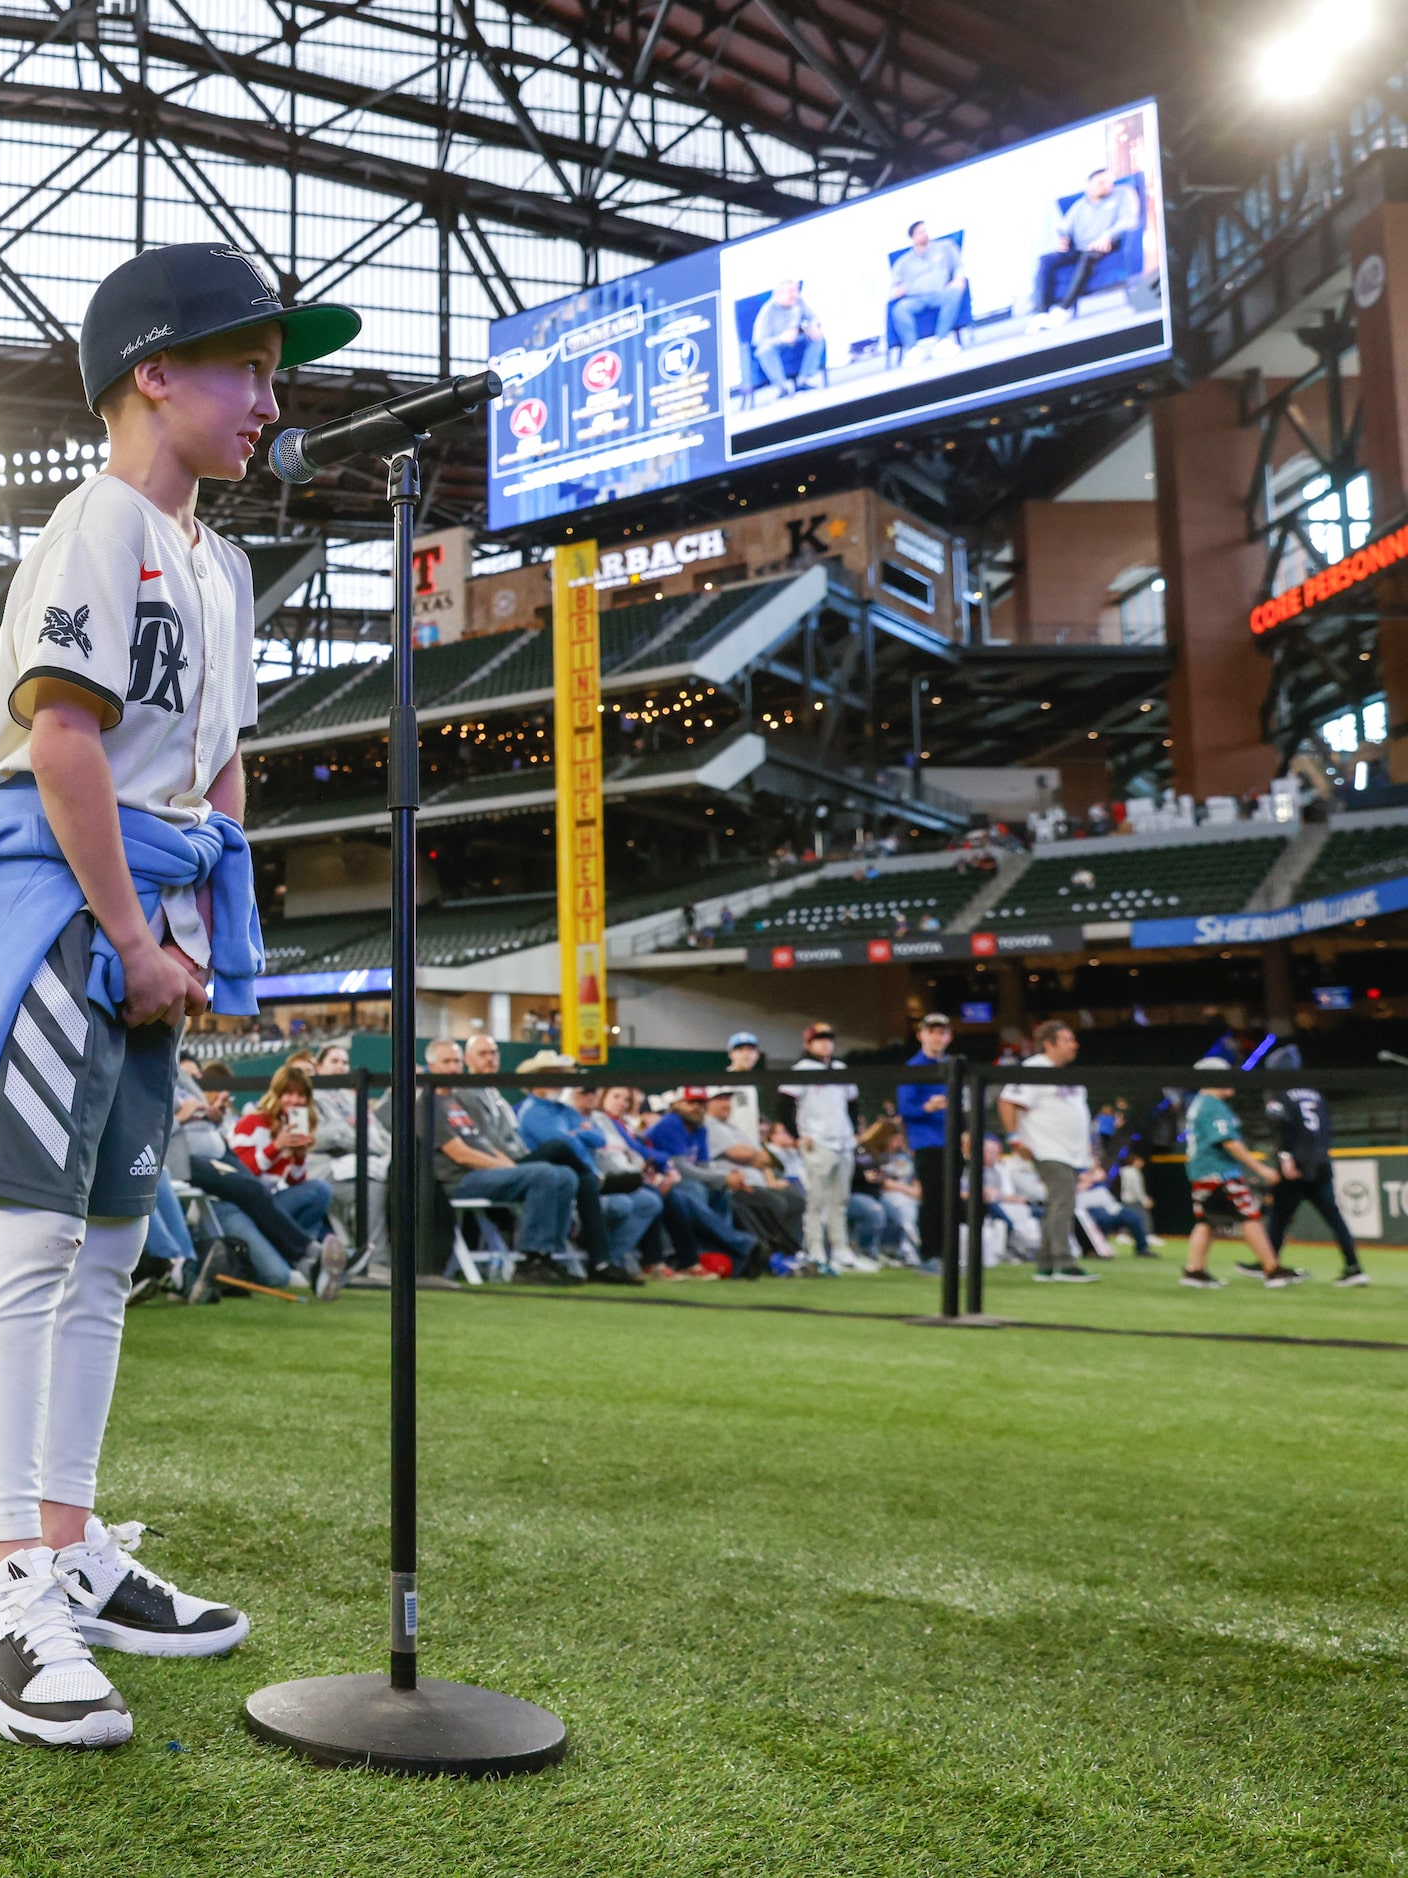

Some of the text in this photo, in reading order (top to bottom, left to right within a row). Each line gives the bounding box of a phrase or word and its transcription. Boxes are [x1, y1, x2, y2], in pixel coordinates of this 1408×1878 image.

[594, 528, 727, 581] RBACH
[412, 589, 453, 616] EXAS
[893, 942, 943, 956] TOYOTA
[998, 934, 1052, 949] TOYOTA
[795, 949, 842, 962] TOYOTA
[1299, 1101, 1321, 1131] 5
